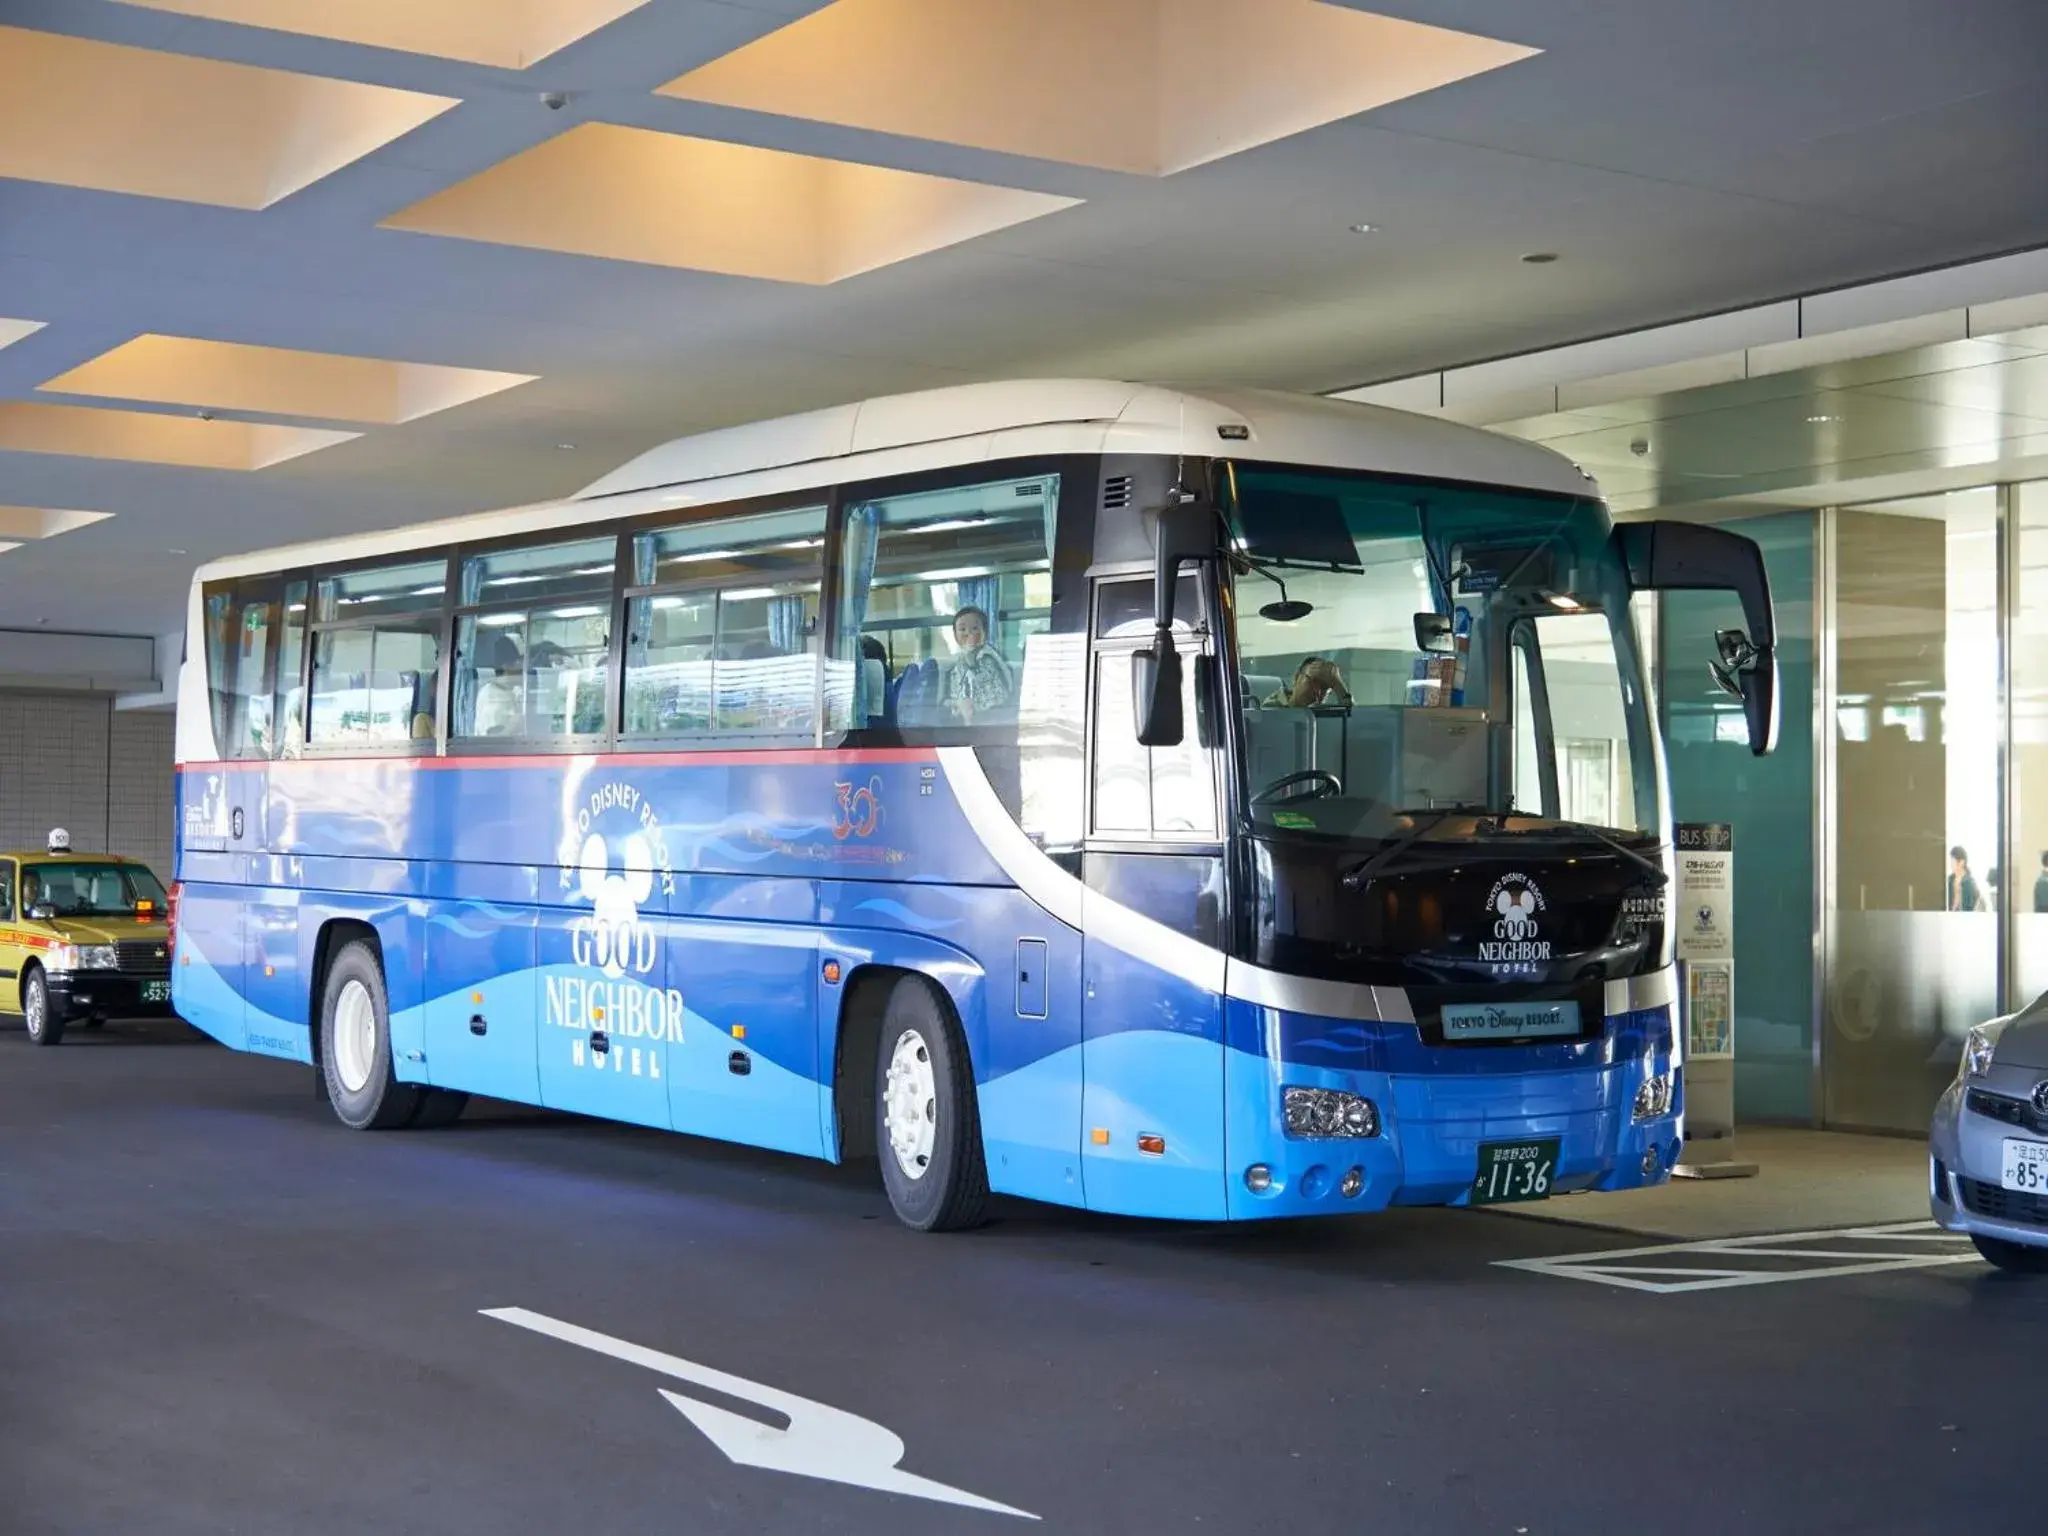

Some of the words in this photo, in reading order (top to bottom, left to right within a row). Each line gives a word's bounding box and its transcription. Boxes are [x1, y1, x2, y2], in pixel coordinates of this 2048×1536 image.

[591, 783, 640, 817] DISNEY
[1680, 829, 1700, 846] BUS
[1703, 830, 1730, 846] STOP
[1501, 872, 1527, 885] DISNEY
[1494, 919, 1538, 939] GOOD
[572, 918, 657, 974] GOOD
[1478, 941, 1551, 961] NEIGHBOR
[1491, 963, 1538, 974] HOTEL
[149, 988, 171, 1000] 52-7
[545, 975, 686, 1045] NEIGHBOR
[1451, 1015, 1486, 1029] TOKYO
[1484, 1006, 1524, 1032] Disney
[1525, 1012, 1561, 1026] RESORT
[572, 1039, 661, 1079] HOTEL
[2017, 1161, 2048, 1188] 85-
